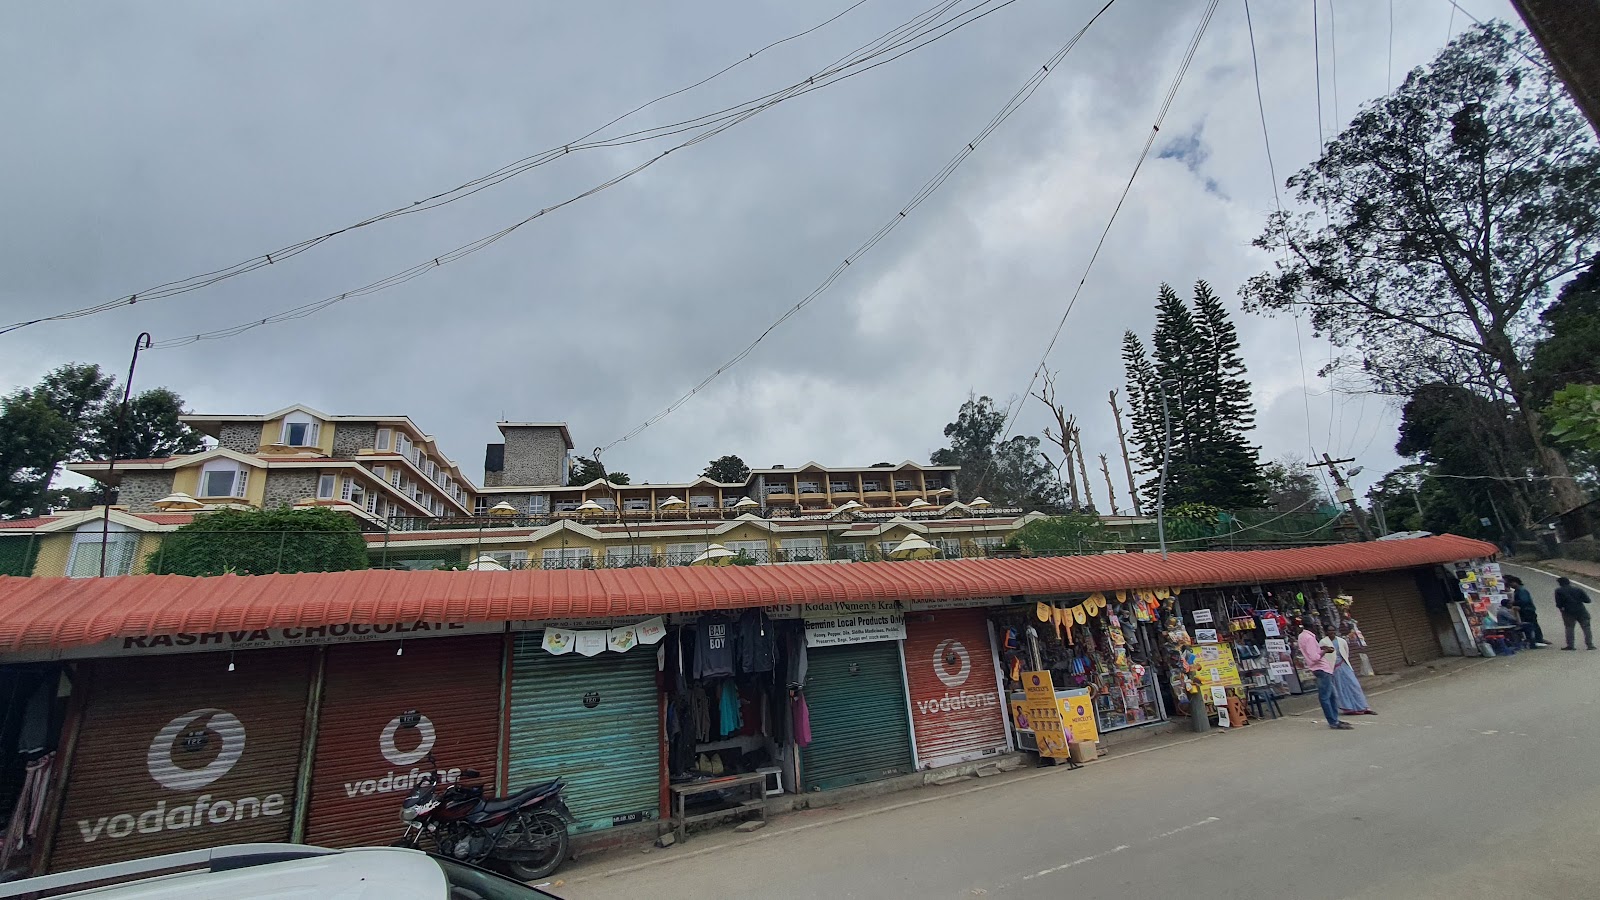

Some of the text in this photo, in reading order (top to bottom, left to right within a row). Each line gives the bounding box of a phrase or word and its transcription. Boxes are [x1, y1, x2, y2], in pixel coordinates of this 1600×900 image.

[805, 602, 833, 611] Kodai
[835, 601, 876, 611] Women's
[805, 614, 905, 630] Genuine Local Products Only
[709, 624, 726, 637] BAD
[710, 638, 725, 650] BOY
[917, 690, 996, 715] vodafone
[77, 793, 285, 843] vodafone
